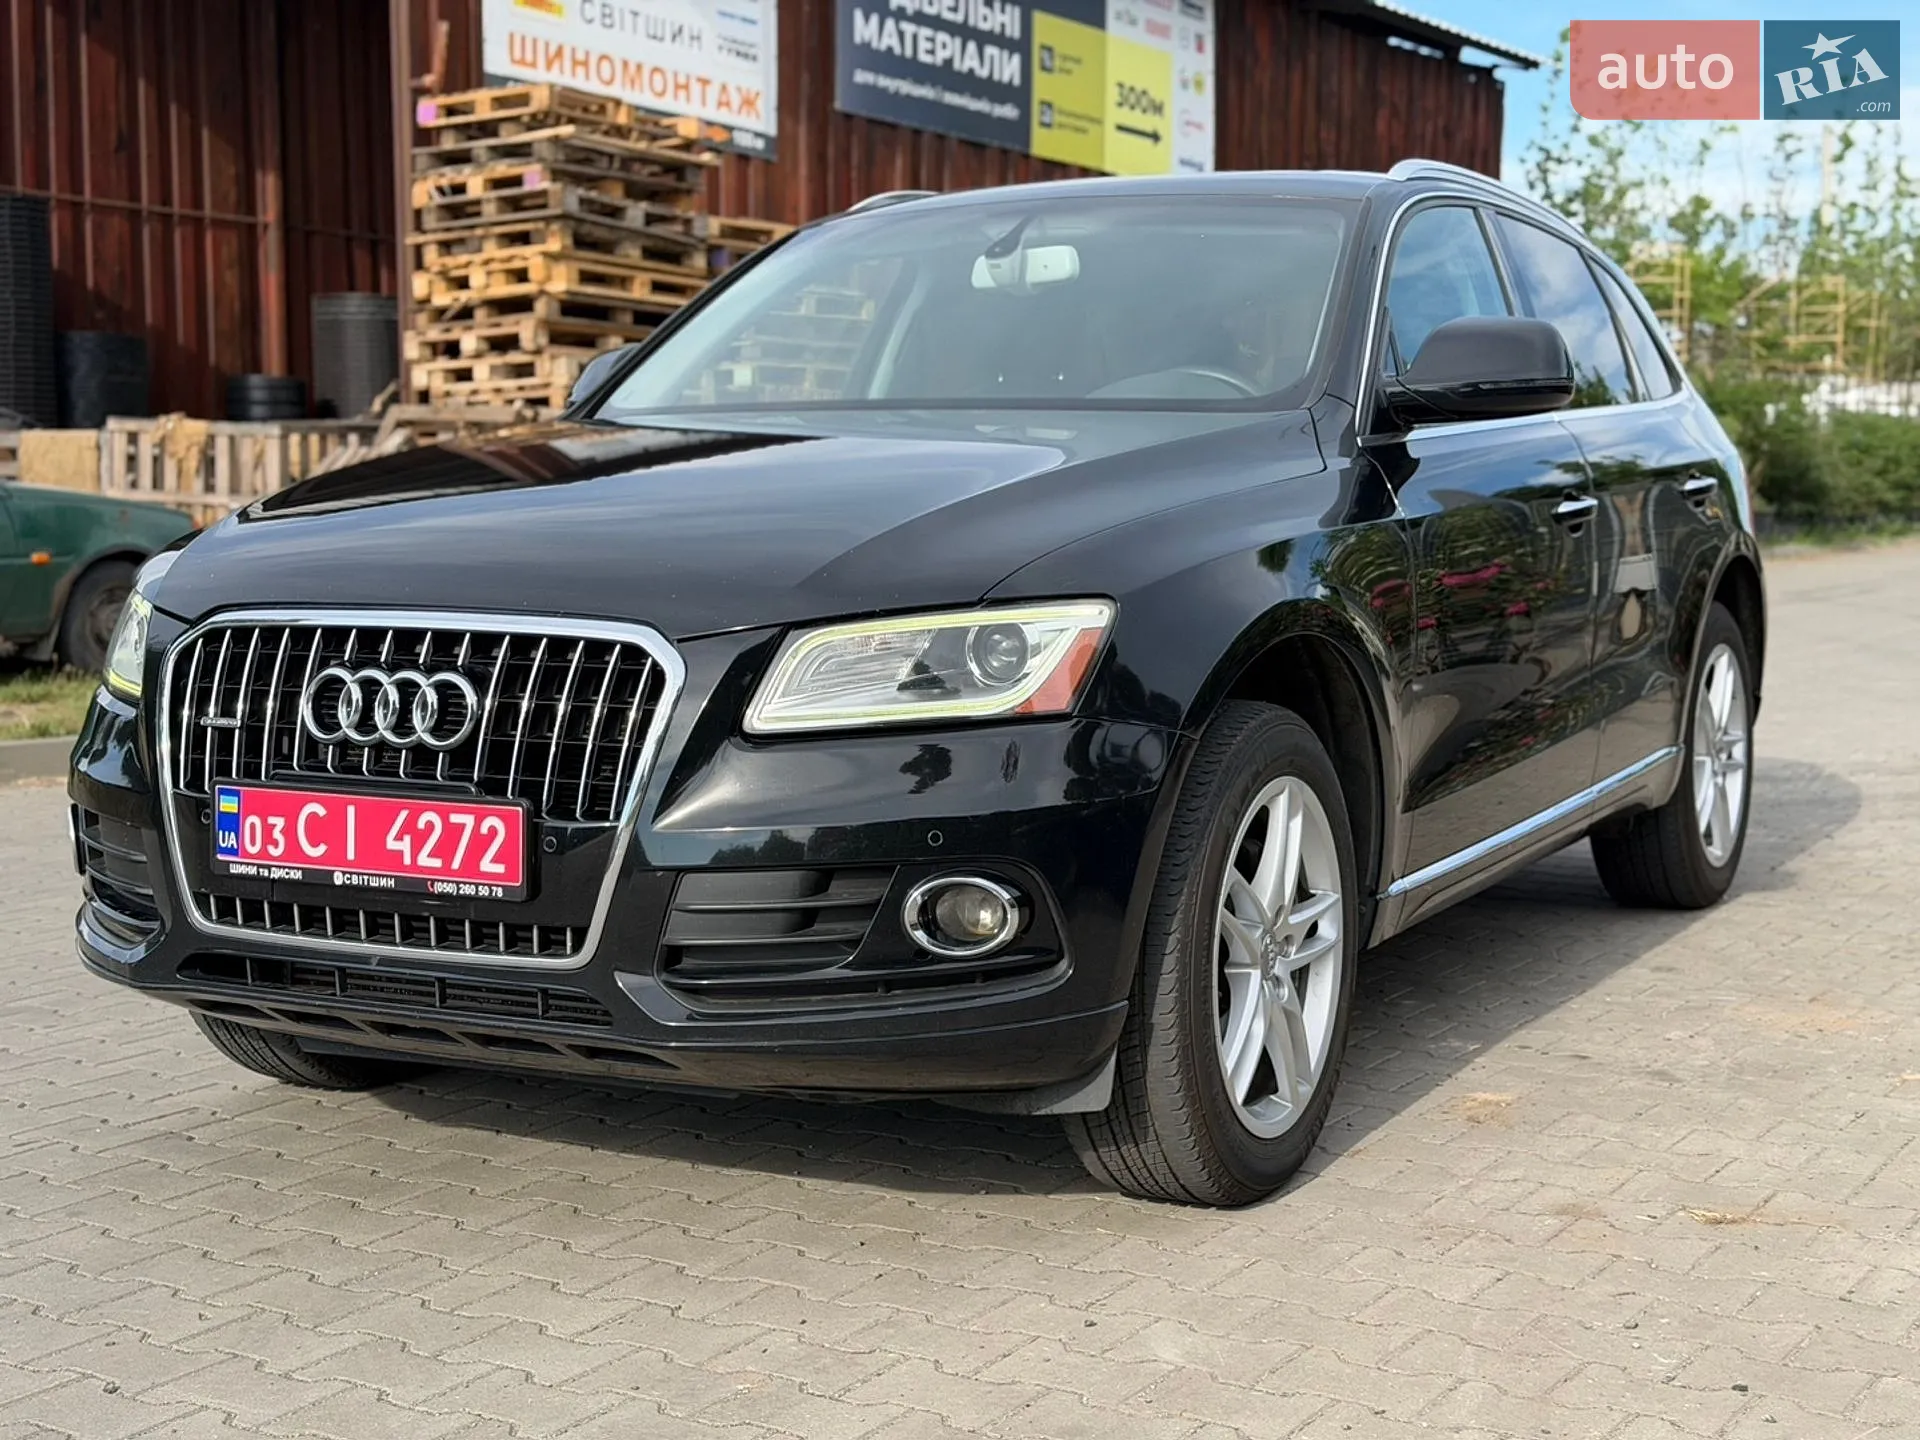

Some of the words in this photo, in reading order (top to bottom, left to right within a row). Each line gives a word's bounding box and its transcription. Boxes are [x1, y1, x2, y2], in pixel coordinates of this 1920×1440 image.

[579, 0, 704, 51] СВІТШИН
[888, 0, 1021, 40] ЕЛЬНІ
[852, 7, 1021, 87] МАТЕРІАЛИ
[508, 31, 762, 120] ШИНОМОНТАЖ
[219, 830, 238, 849] UA
[243, 814, 285, 857] 03
[385, 809, 506, 874] 4272
[229, 863, 257, 876] ШИНИ
[259, 868, 268, 877] та
[270, 867, 302, 880] ДИСКИ
[344, 873, 395, 888] СВІТШИН
[434, 881, 457, 896] (050)
[478, 885, 489, 896] 50
[491, 886, 503, 897] 78
